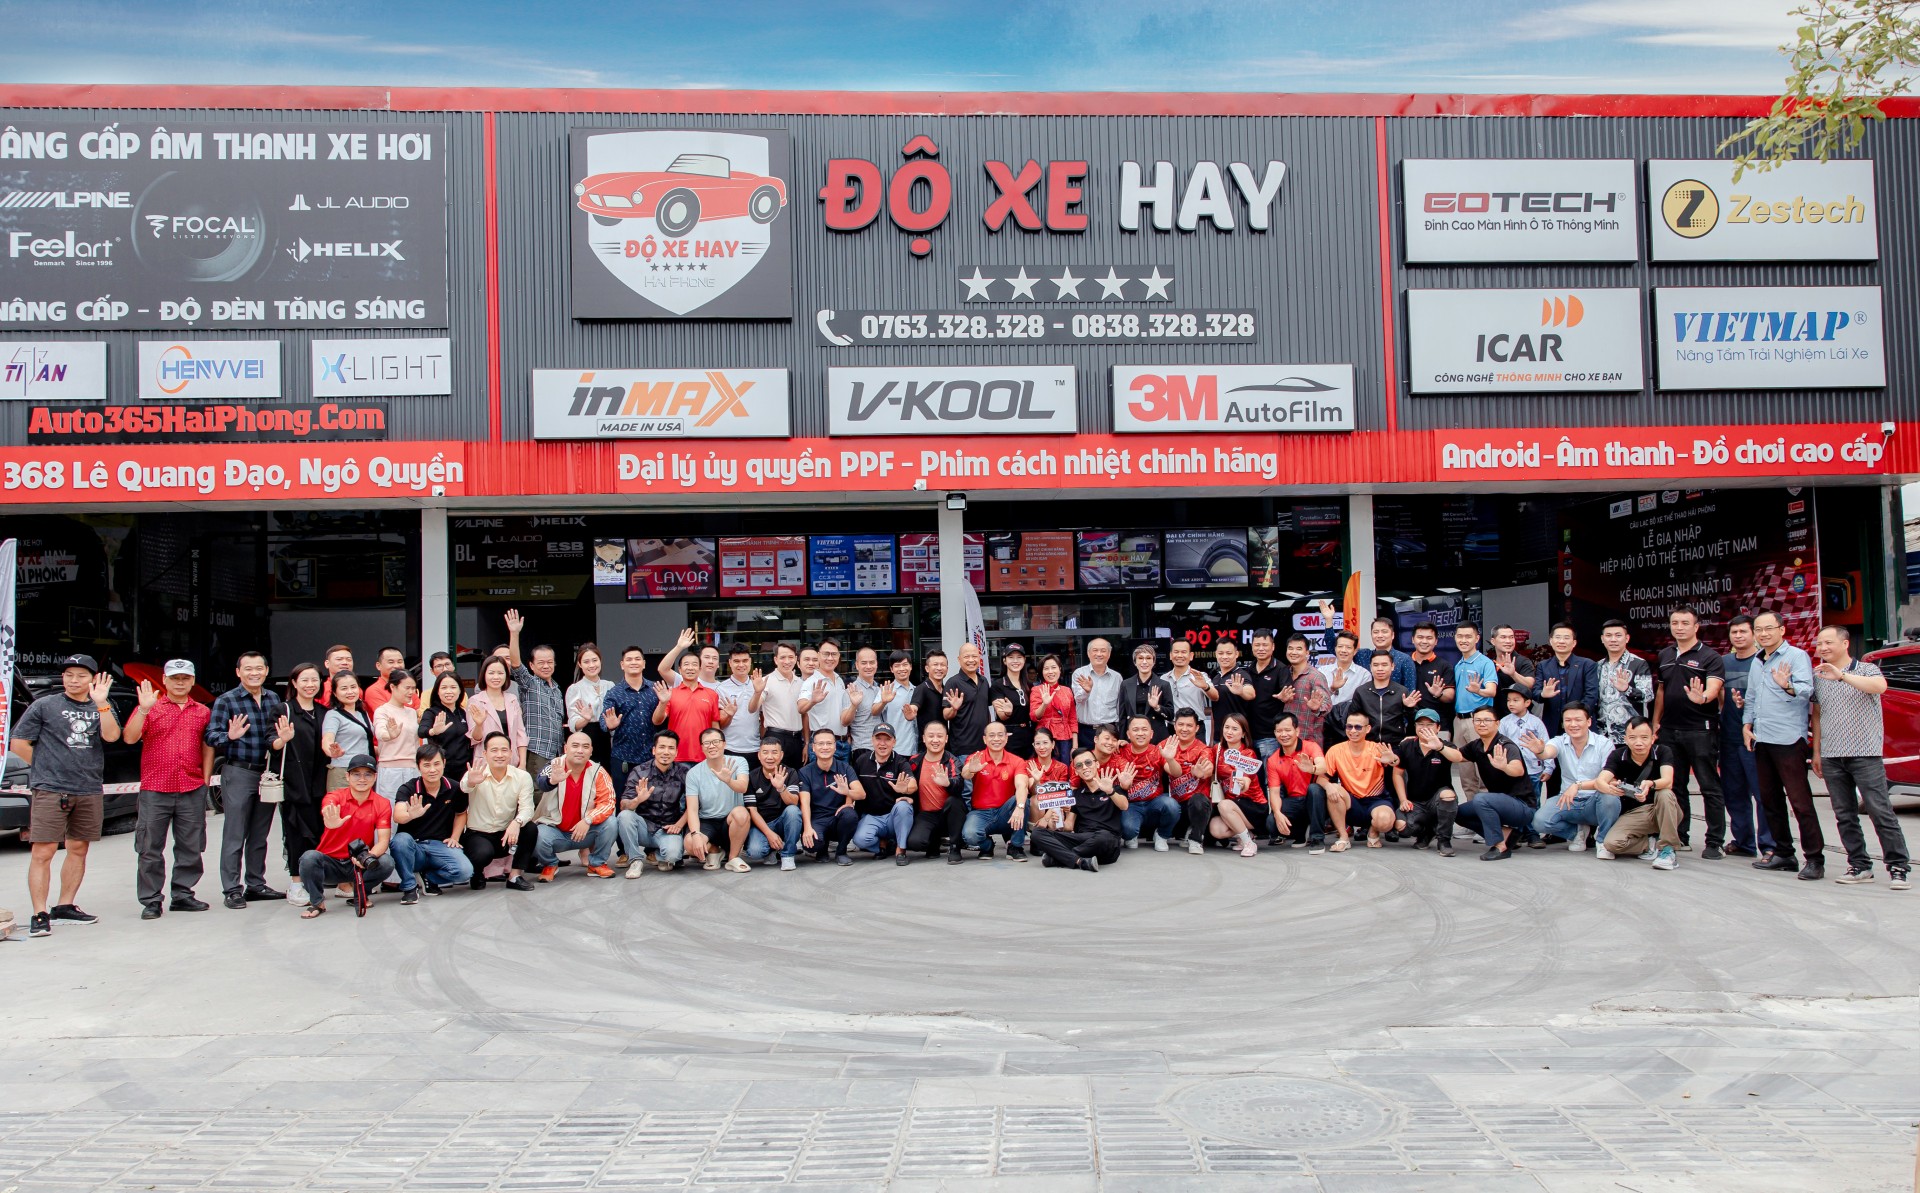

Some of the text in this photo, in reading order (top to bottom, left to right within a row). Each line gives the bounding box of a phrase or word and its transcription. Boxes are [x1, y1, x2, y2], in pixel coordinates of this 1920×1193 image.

[0, 123, 431, 161] ÂNG CẤP ÂM THANH XE HƠI
[2, 191, 133, 208] ALPINE
[317, 197, 409, 209] JL AUDIO
[819, 134, 1287, 256] ĐỘ XE HAY
[1423, 192, 1616, 213] GOTECH
[1726, 194, 1865, 224] Zestech
[172, 217, 255, 233] FOCAL
[1451, 219, 1474, 231] Cao
[1476, 217, 1501, 231] Màn
[1503, 218, 1528, 231] Hình
[1529, 217, 1539, 230] Ô
[1541, 218, 1555, 230] Tô
[1557, 218, 1592, 233] Thông
[1594, 218, 1619, 230] Minh
[10, 231, 113, 258] Feelart
[314, 240, 405, 260] HELIX
[624, 235, 739, 262] ĐỘ XE HAY
[76, 294, 129, 321] CẤP
[158, 298, 201, 326] ĐỘ
[211, 297, 265, 320] ĐÈN
[274, 297, 346, 320] TĂNG
[354, 295, 425, 320] SÁNG
[861, 314, 1045, 339] 0763.328.328
[1072, 312, 1254, 338] 0838.328.328
[1673, 311, 1850, 342] VIETMAP
[1476, 333, 1564, 363] ICAR
[1676, 346, 1869, 364] Nâng Tầm Trải Nghiệm Lái Xe
[321, 353, 442, 383] X-LIGHT
[1434, 371, 1622, 385] CÔNG NGHỆ THÔNG MINH CHO XE BẠN
[847, 380, 1055, 421] V-KOOL
[1128, 374, 1218, 422] 3M
[29, 404, 386, 435] Auto365HaiPhong.Com
[1224, 401, 1342, 424] AutoFilm
[600, 423, 682, 433] MADE IN USA
[1442, 442, 1540, 468] Android
[1557, 436, 1599, 467] Âm
[1605, 441, 1675, 466] thanh
[1693, 434, 1729, 465] Đồ
[1734, 437, 1785, 464] chơi
[1789, 443, 1835, 464] cao
[1840, 432, 1883, 468] cấp
[4, 452, 463, 493] 368 Lê Quang Đạo, Ngô Quyền
[617, 452, 664, 485] Đại
[673, 452, 696, 487] lý
[704, 451, 737, 486] ủy
[745, 447, 831, 486] quyền
[841, 451, 893, 477] PPF
[920, 449, 989, 477] Phim
[997, 449, 1057, 476] cách
[1064, 446, 1131, 480] nhiệt
[1138, 447, 1207, 475] chính
[1214, 446, 1278, 480] hãng
[455, 519, 505, 528] ALPINE
[541, 516, 587, 527] HELIX
[510, 534, 543, 543] AUDIO
[546, 541, 584, 551] ESB
[1656, 534, 1672, 546] GIA
[1674, 525, 1702, 544] NHẬP
[455, 544, 476, 562] BL
[487, 554, 538, 570] Feelart
[1599, 535, 1757, 575] HIỆP HỘI Ô TÔ THỂ THAO VIỆT NAM
[654, 571, 708, 584] LAVOR
[1620, 577, 1732, 603] KẾ HOẠCH SINH NHẬT 10
[1300, 616, 1320, 627] 3M
[1630, 604, 1664, 620] OTOFUN
[1185, 624, 1212, 649] ĐỘ
[1037, 782, 1071, 794] OTOFUN
